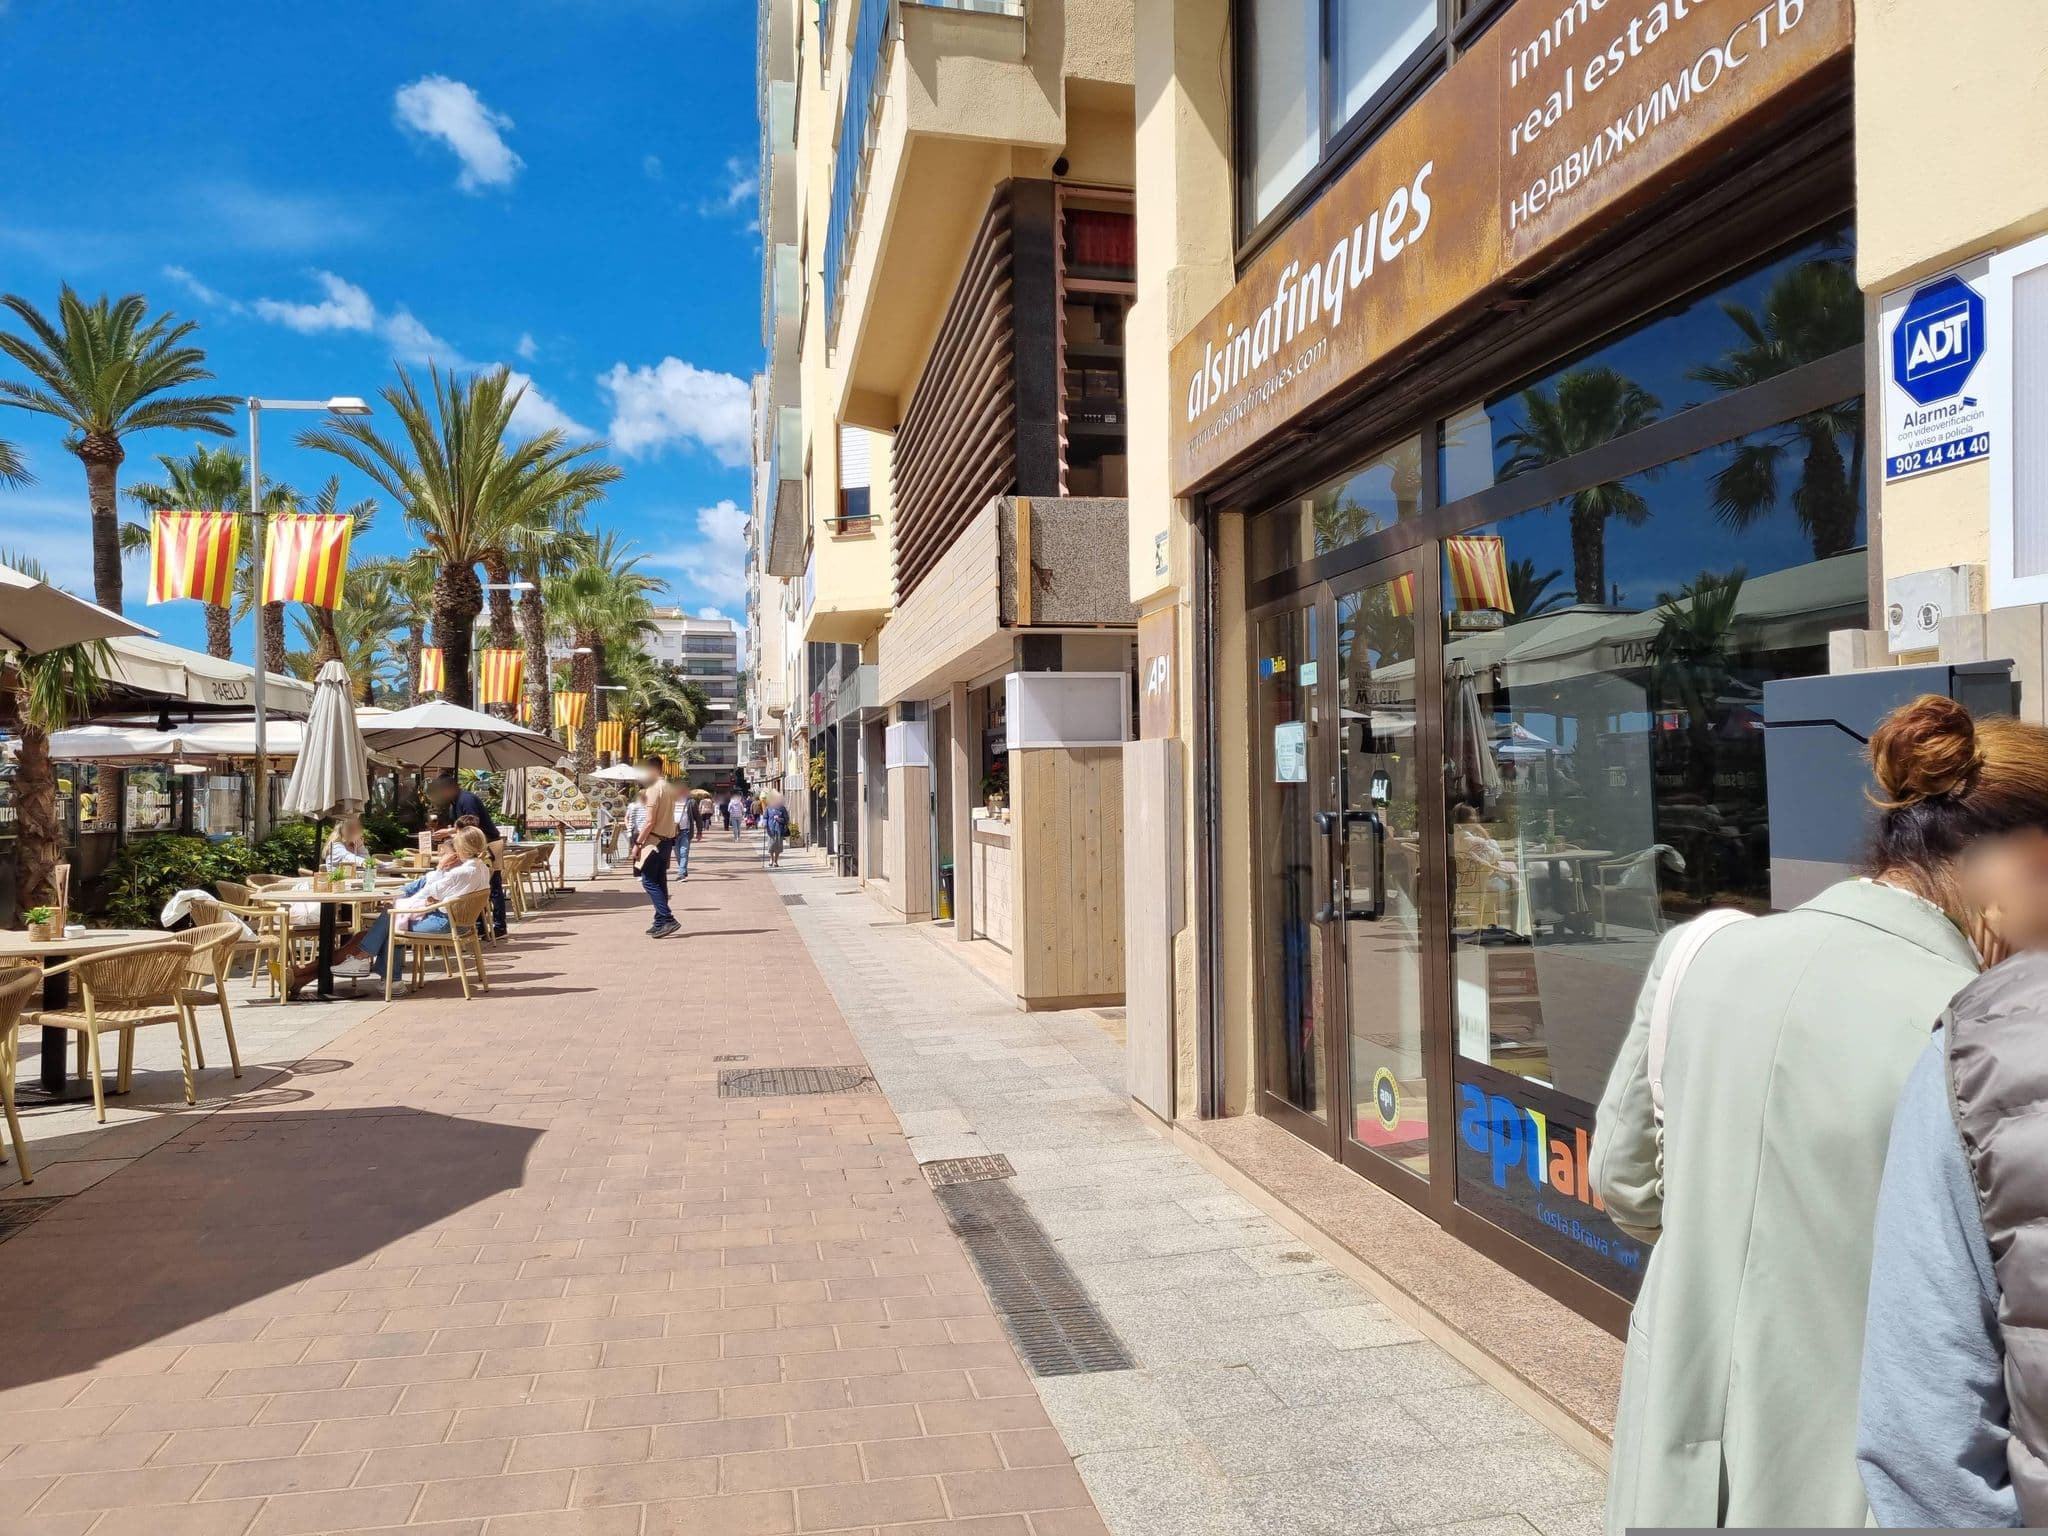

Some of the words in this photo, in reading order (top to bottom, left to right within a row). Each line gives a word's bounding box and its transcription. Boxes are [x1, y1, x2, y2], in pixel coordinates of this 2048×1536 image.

[1511, 66, 1573, 157] real
[1584, 0, 1706, 92] esta
[1187, 160, 1434, 423] alsinafinques
[1907, 311, 1969, 371] ADT
[1188, 337, 1327, 457] www.alsinafinques.com
[1903, 404, 1957, 430] Alarma
[1896, 453, 1921, 474] 902
[1925, 447, 1943, 465] 44
[1947, 441, 1966, 459] 44
[1969, 435, 1988, 454] 40
[1897, 431, 1913, 441] con
[1908, 442, 1914, 451] y
[1915, 436, 1937, 448] aviso
[1938, 433, 1944, 441] a
[212, 682, 247, 701] PAELLA
[1147, 653, 1170, 697] API
[1536, 1202, 1569, 1234] Costa
[1570, 1218, 1608, 1257] Brava
